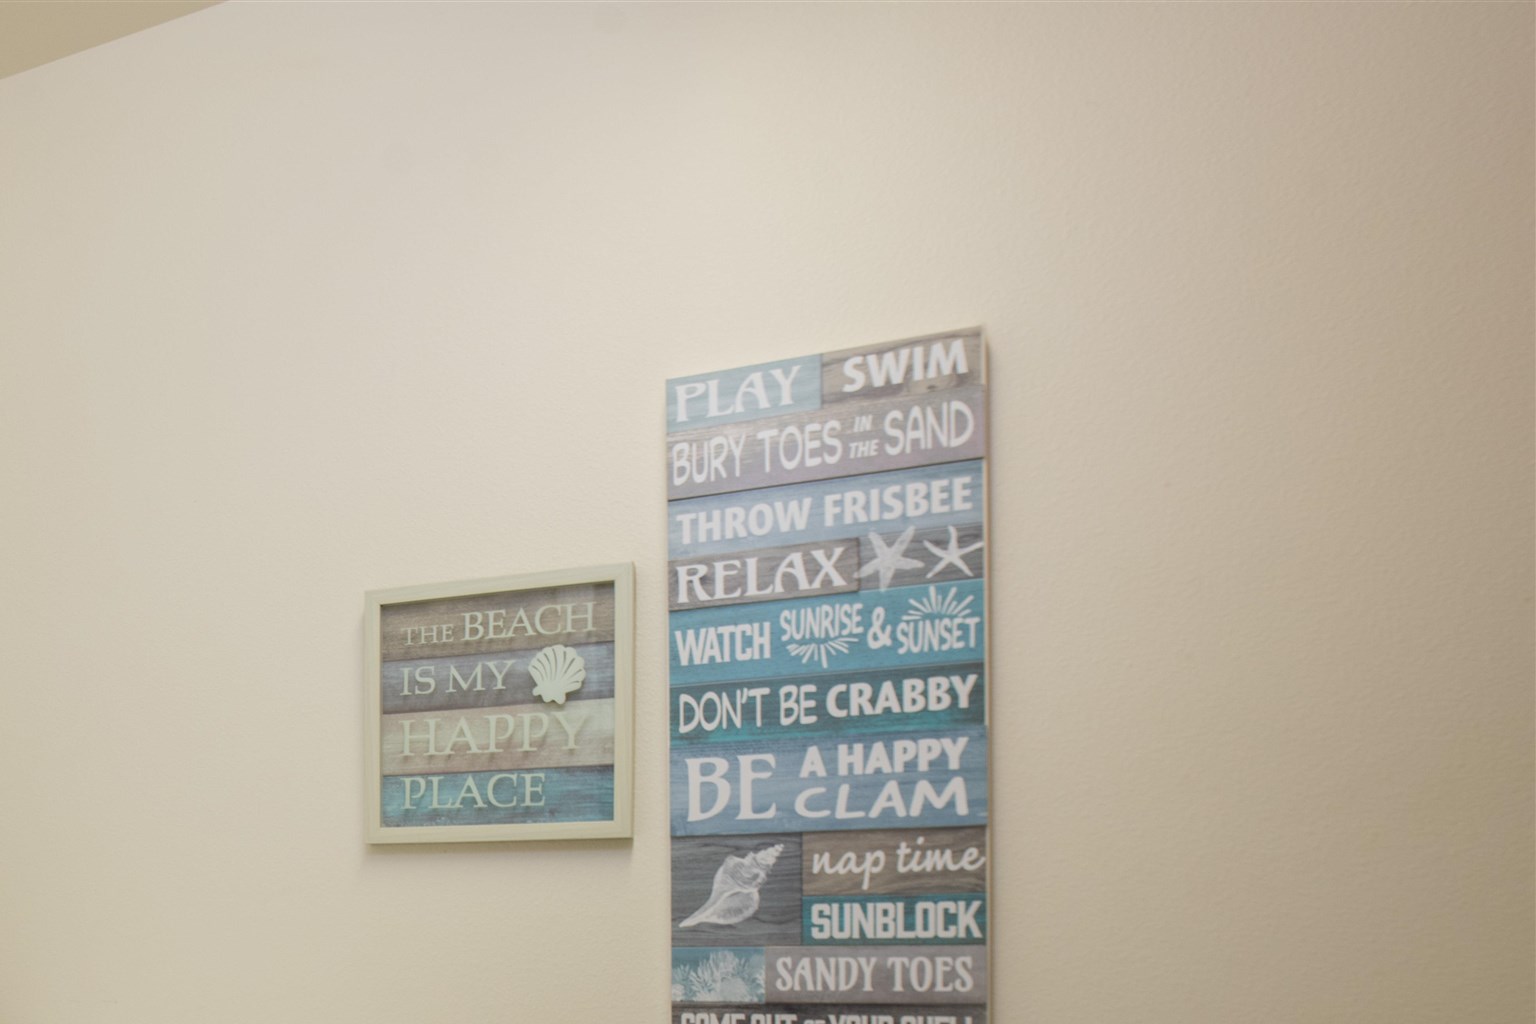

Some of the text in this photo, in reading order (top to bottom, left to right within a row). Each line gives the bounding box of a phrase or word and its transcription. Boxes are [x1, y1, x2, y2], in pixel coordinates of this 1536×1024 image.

[842, 338, 969, 393] SWIM
[675, 365, 802, 422] PLAY
[672, 400, 975, 486] BURY TOES IN THE SAND
[676, 476, 974, 545] THROW FRISBEE
[675, 547, 849, 604] RELAX
[401, 602, 596, 646] THE BEACH
[674, 602, 981, 666] WATCH SUNRISE & SUNSET
[400, 659, 516, 696] IS MY
[679, 673, 979, 734] DON'T BE CRABBY
[399, 712, 589, 757] HAPPY
[400, 773, 546, 810] PLACE
[684, 736, 969, 822] BE A HAPPY
[794, 776, 969, 819] CLAM
[812, 835, 987, 890] nap time
[810, 900, 984, 939] SUNBLOCK
[776, 955, 974, 992] SANDY TOES
